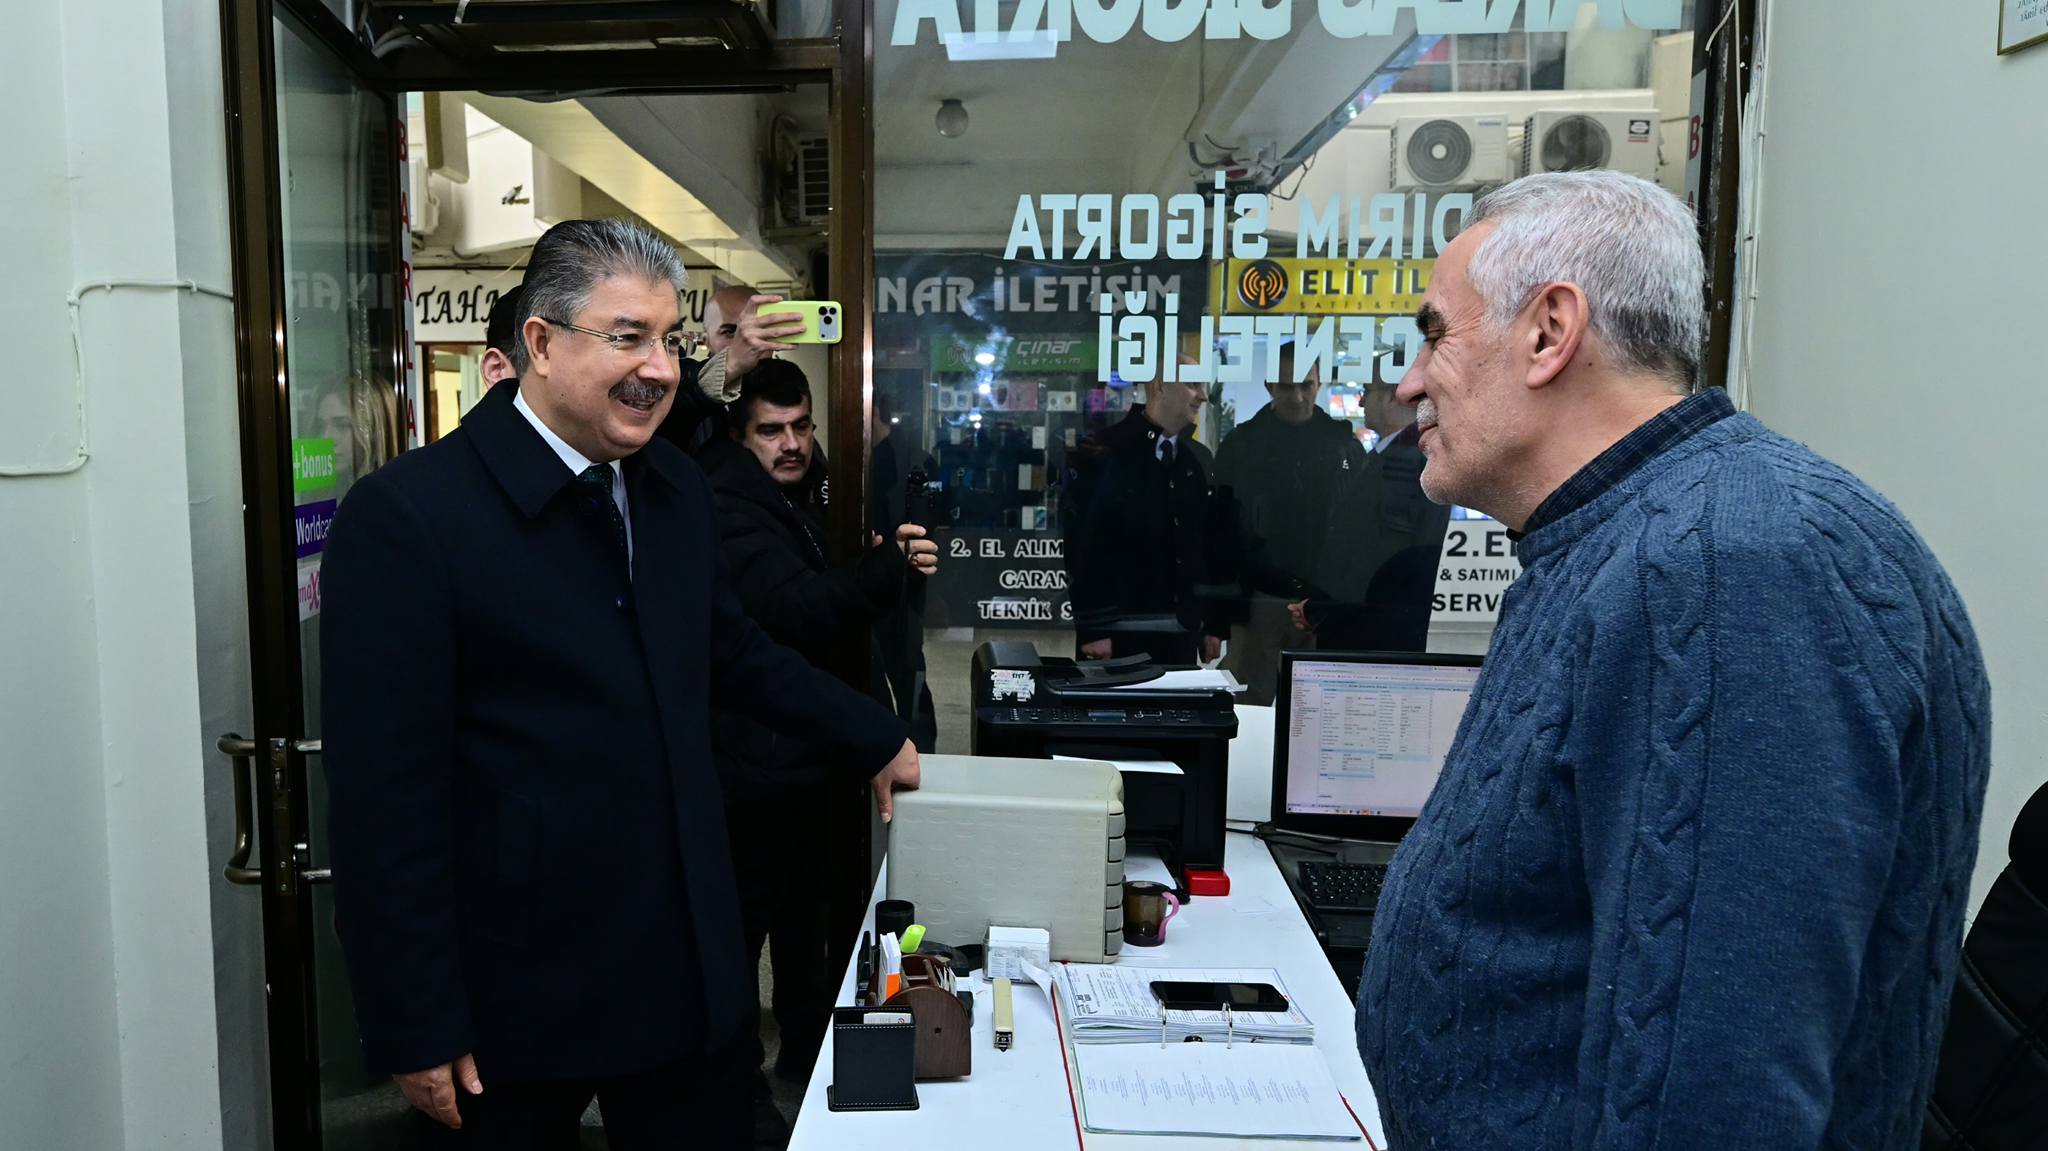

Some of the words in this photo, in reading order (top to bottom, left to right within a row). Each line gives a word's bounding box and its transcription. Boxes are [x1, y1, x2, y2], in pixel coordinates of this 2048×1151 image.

[1301, 261, 1379, 295] ELİT
[873, 275, 976, 317] NAR
[295, 511, 336, 546] Worldca
[950, 538, 971, 557] 2.
[980, 538, 1005, 557] EL
[1013, 538, 1064, 558] ALIM
[1440, 568, 1452, 581] &
[978, 597, 1052, 620] TEKNİK
